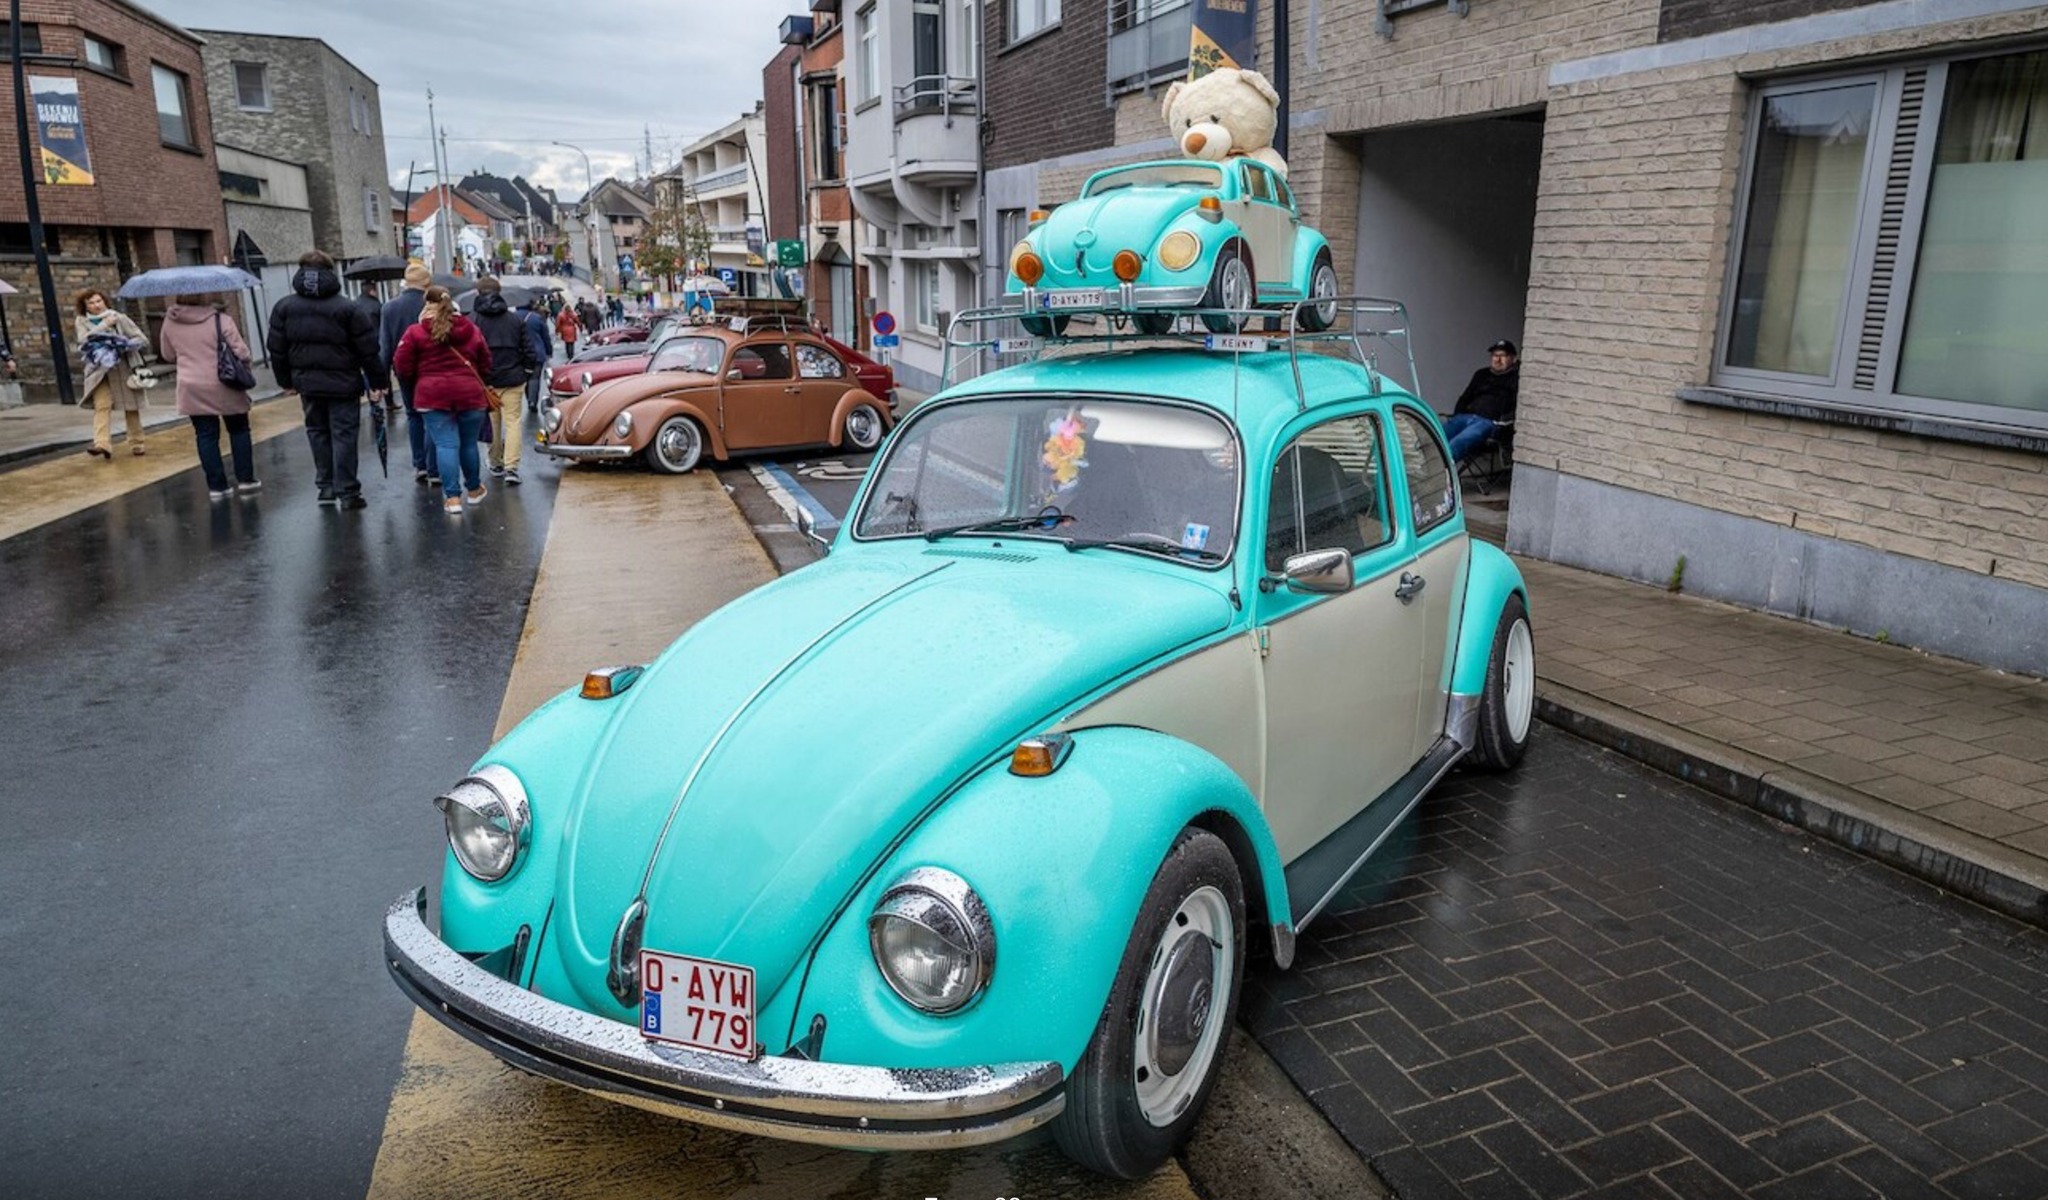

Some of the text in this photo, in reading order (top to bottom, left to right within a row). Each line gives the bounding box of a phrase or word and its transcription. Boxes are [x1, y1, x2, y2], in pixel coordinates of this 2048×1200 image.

[722, 270, 733, 282] P
[647, 1014, 657, 1029] B
[687, 1005, 748, 1049] 779
